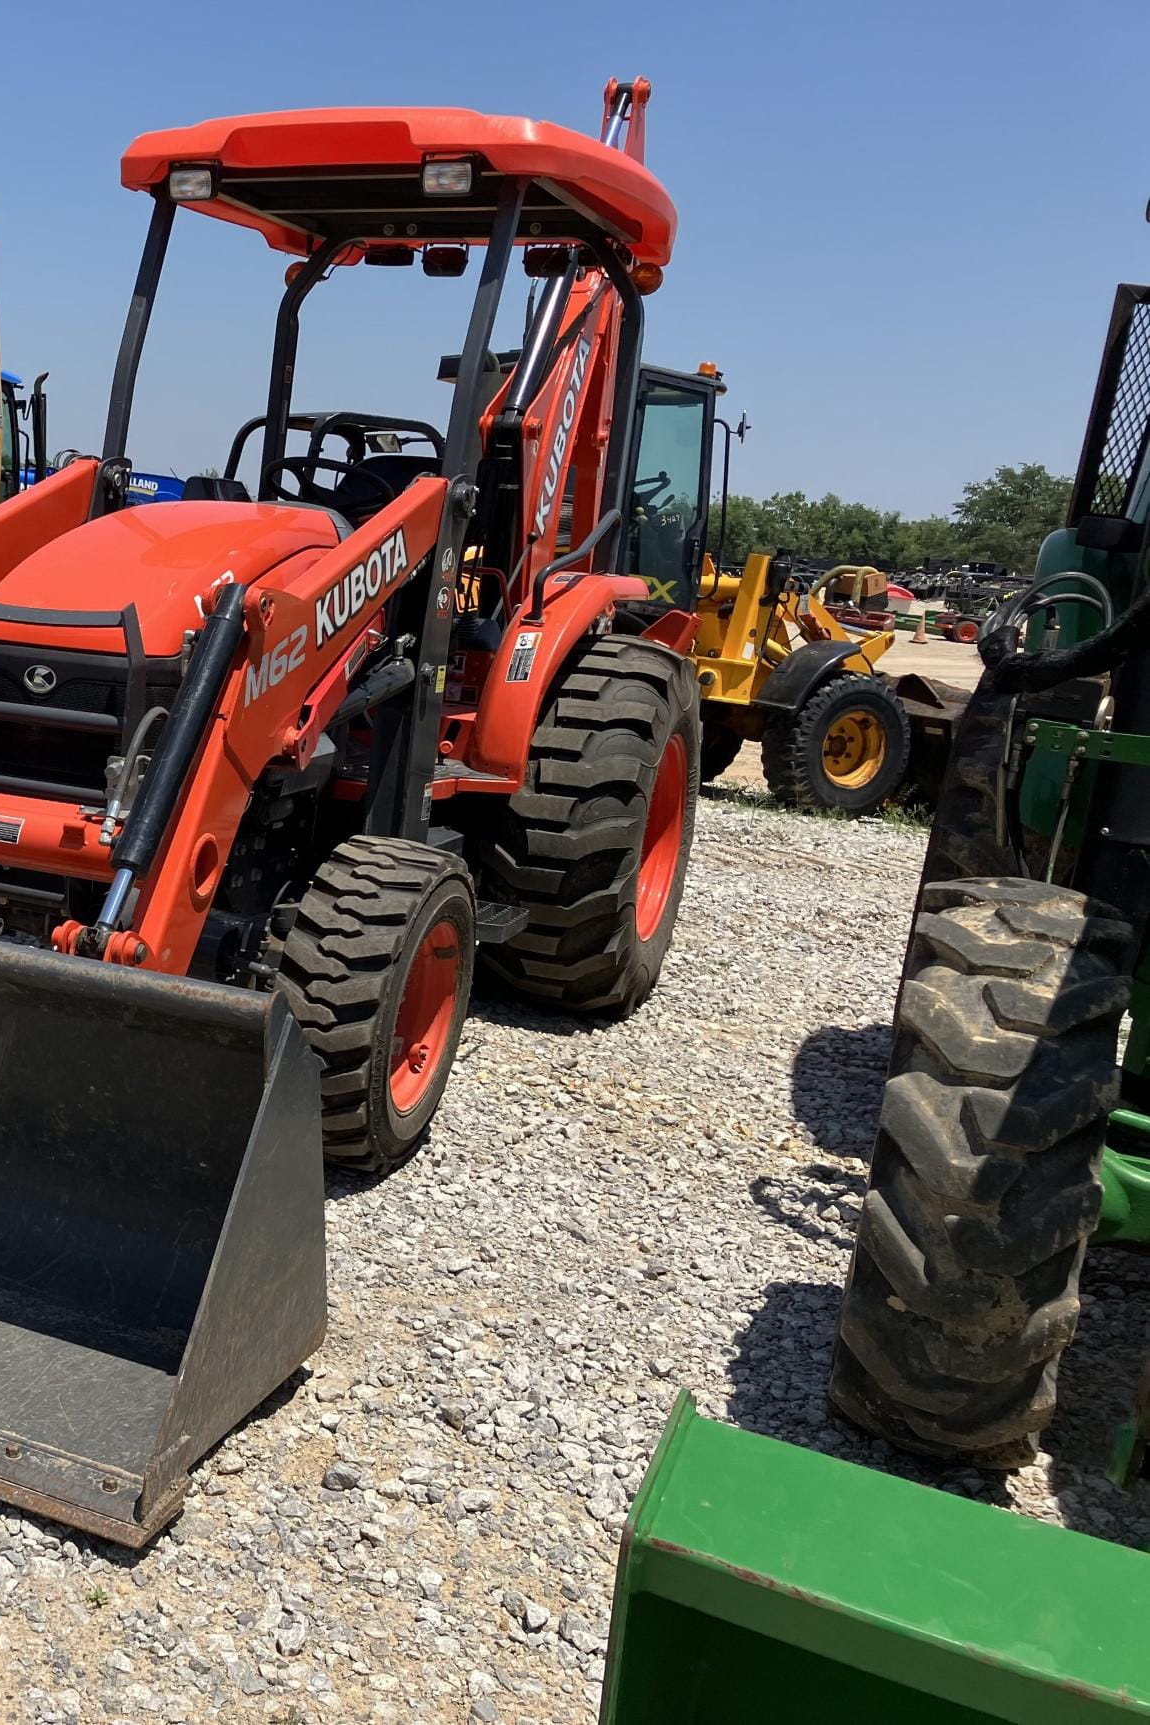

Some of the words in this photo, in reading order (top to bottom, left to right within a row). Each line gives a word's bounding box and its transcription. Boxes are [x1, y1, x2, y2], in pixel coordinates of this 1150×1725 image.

[535, 336, 591, 537] KUBOTA
[244, 624, 308, 708] M62
[315, 528, 408, 648] KUBOTA
